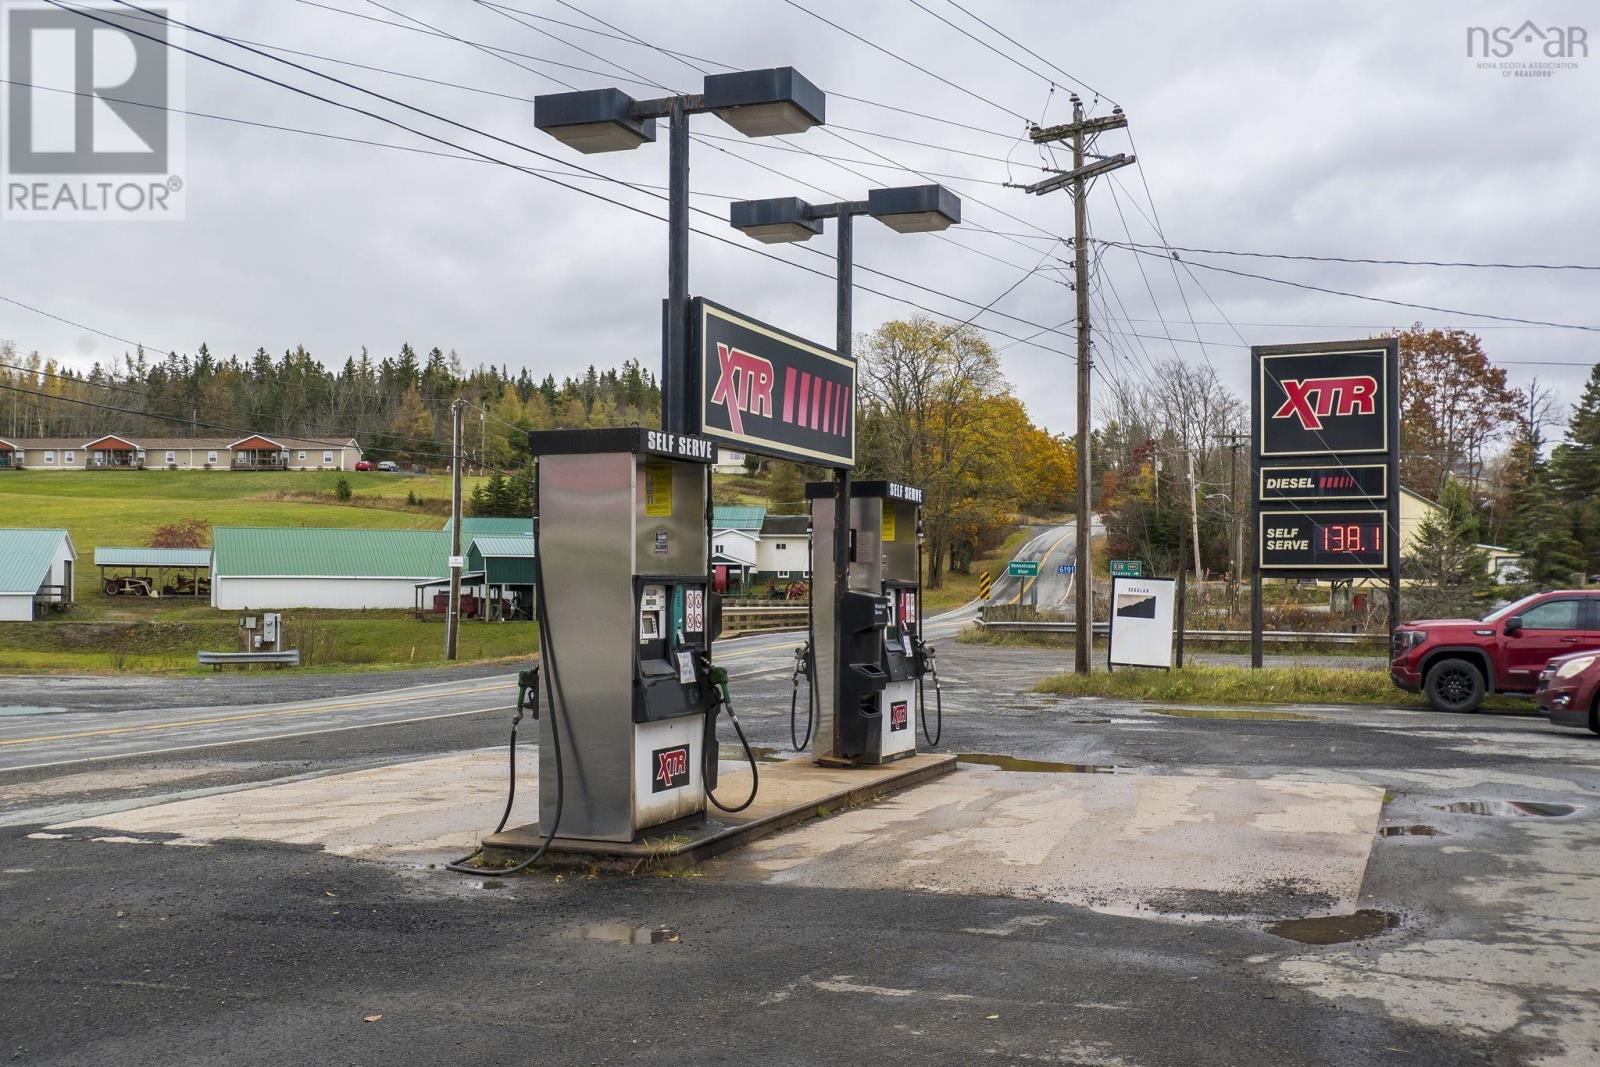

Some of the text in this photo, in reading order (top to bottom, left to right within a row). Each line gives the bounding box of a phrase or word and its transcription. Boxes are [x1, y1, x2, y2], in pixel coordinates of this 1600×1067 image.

[711, 341, 774, 434] XTR
[1272, 376, 1377, 430] XTR
[647, 431, 712, 458] SELF SERVE
[890, 483, 922, 502] SELF SERVE
[1267, 478, 1315, 488] DIESEL
[1267, 528, 1299, 538] SELF
[1267, 540, 1309, 550] SERVE
[1325, 526, 1380, 551] 138.1
[656, 749, 687, 787] XTR
